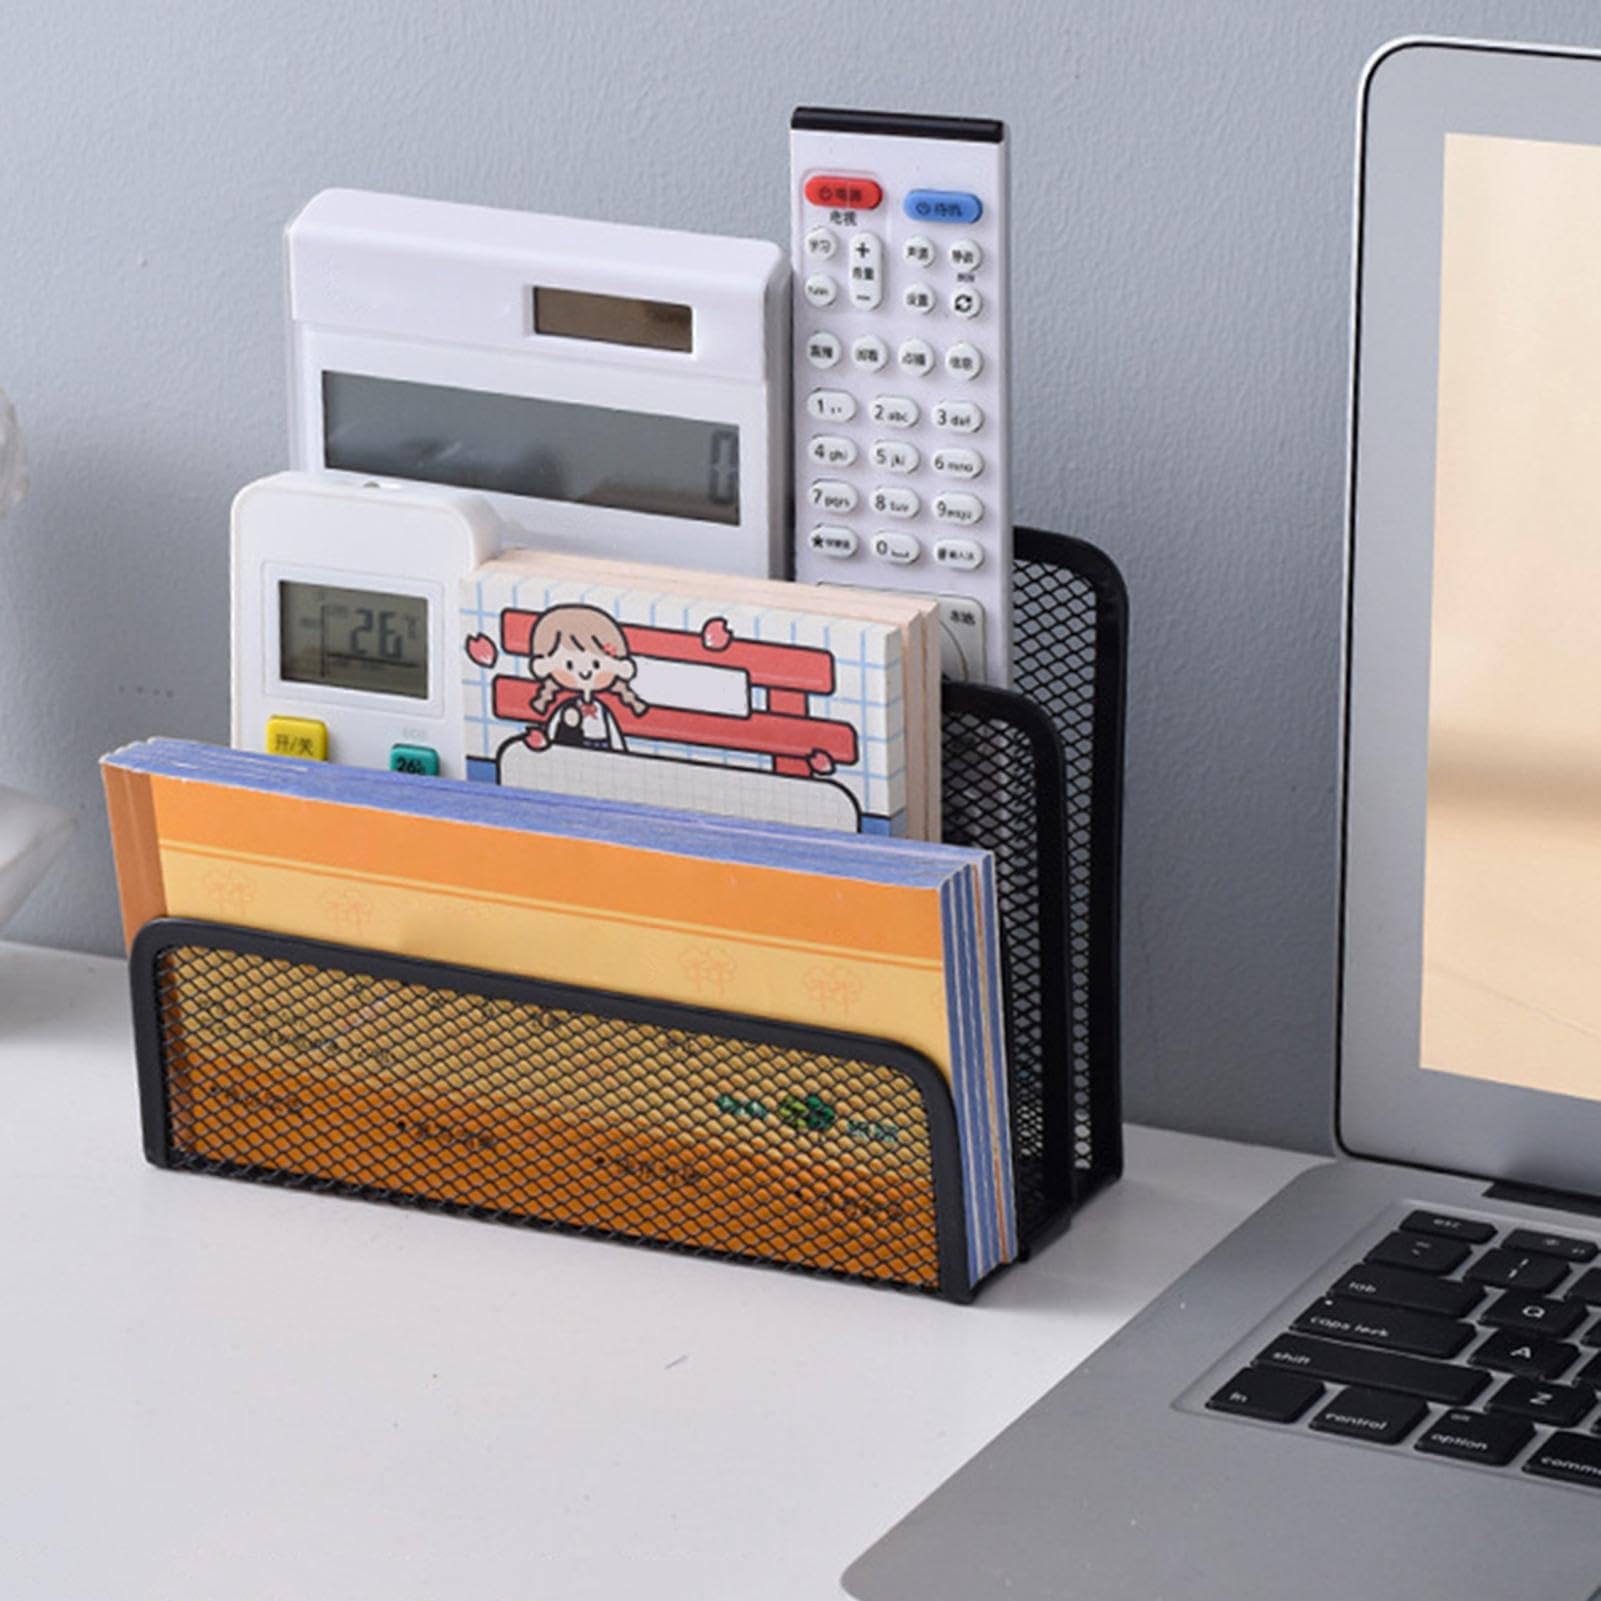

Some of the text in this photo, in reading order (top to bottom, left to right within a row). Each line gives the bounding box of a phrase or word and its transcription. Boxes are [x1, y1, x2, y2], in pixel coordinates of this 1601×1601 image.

[817, 399, 824, 413] 1
[874, 405, 884, 421] 2
[937, 409, 947, 426] 3
[814, 444, 825, 459] 4
[876, 449, 886, 464] 5
[934, 455, 945, 470] 6
[812, 488, 823, 504] 7
[875, 494, 886, 511] 8
[936, 500, 947, 517] 9
[876, 540, 888, 555] 0
[350, 607, 403, 659] 26
[1349, 1281, 1376, 1293] tab
[1522, 1305, 1546, 1319] Q
[1310, 1316, 1389, 1337] caps lock
[1273, 1351, 1311, 1365] shift
[1509, 1346, 1532, 1359] A
[1529, 1392, 1553, 1406] Z
[1325, 1412, 1387, 1430] control
[1431, 1433, 1488, 1450] option
